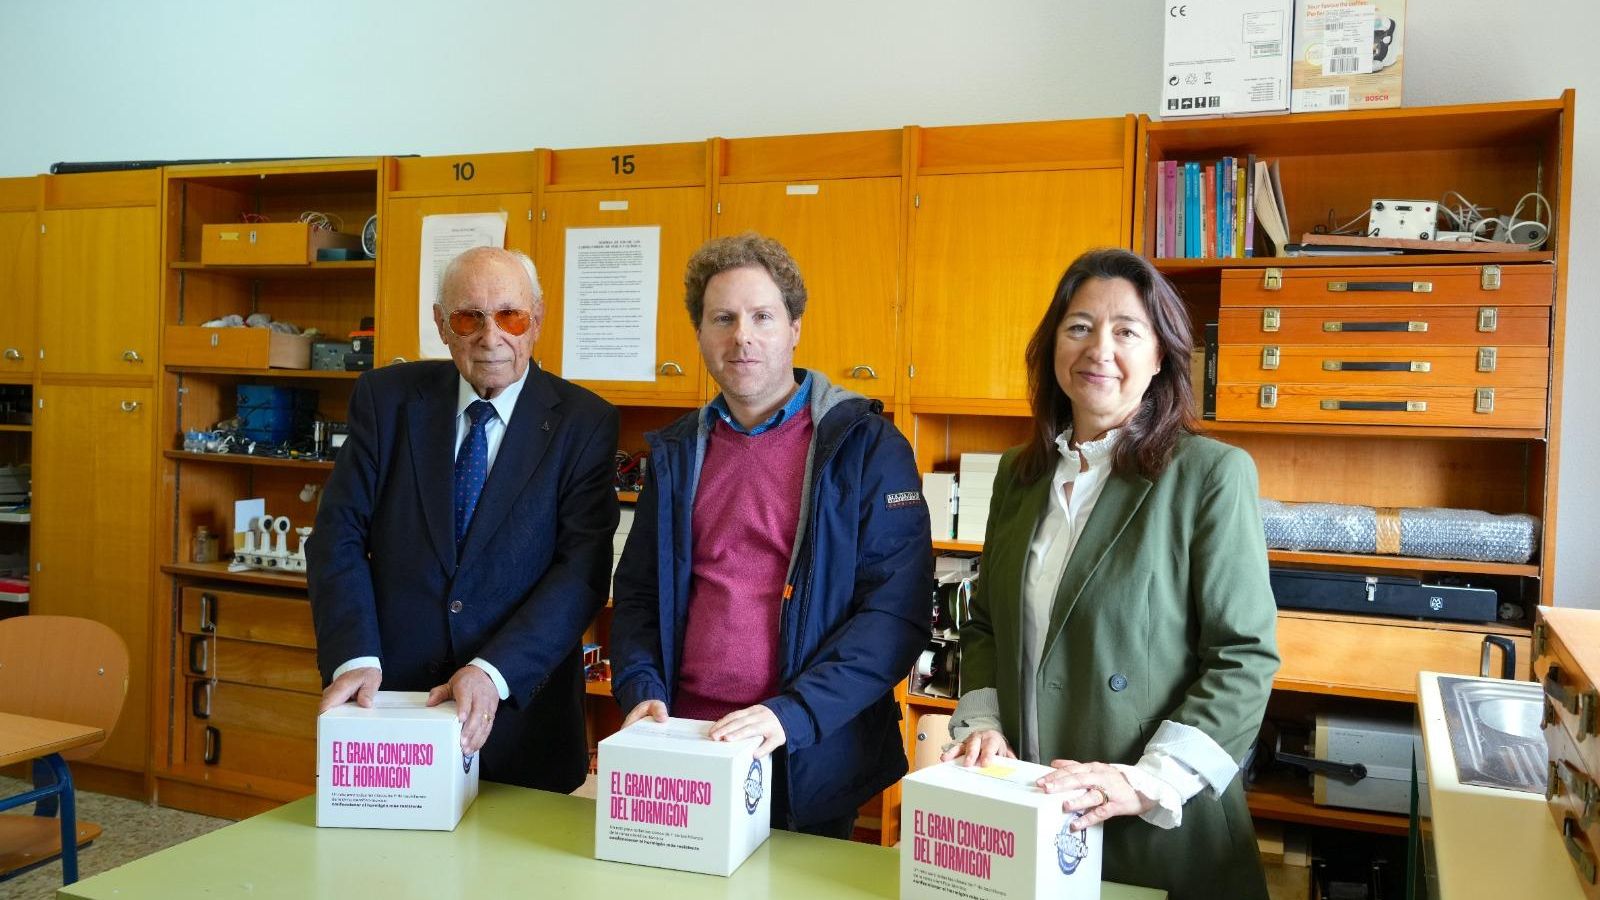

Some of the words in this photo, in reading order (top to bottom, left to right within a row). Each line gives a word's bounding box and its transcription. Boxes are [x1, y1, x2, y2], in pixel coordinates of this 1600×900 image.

[453, 161, 475, 181] 10
[611, 155, 635, 175] 15
[332, 741, 345, 763] EL
[346, 742, 375, 764] GRAN
[376, 743, 434, 766] CONCURSO
[332, 765, 352, 787] DEL
[611, 771, 622, 795] EL
[624, 773, 652, 798] GRAN
[654, 776, 711, 806] CONCURSO
[610, 796, 629, 820] DEL
[631, 798, 689, 828] HORMIGÓN
[914, 809, 926, 836] EL
[927, 813, 955, 843] GRAN
[957, 819, 1015, 858] CONCURSO
[914, 836, 932, 864] DEL
